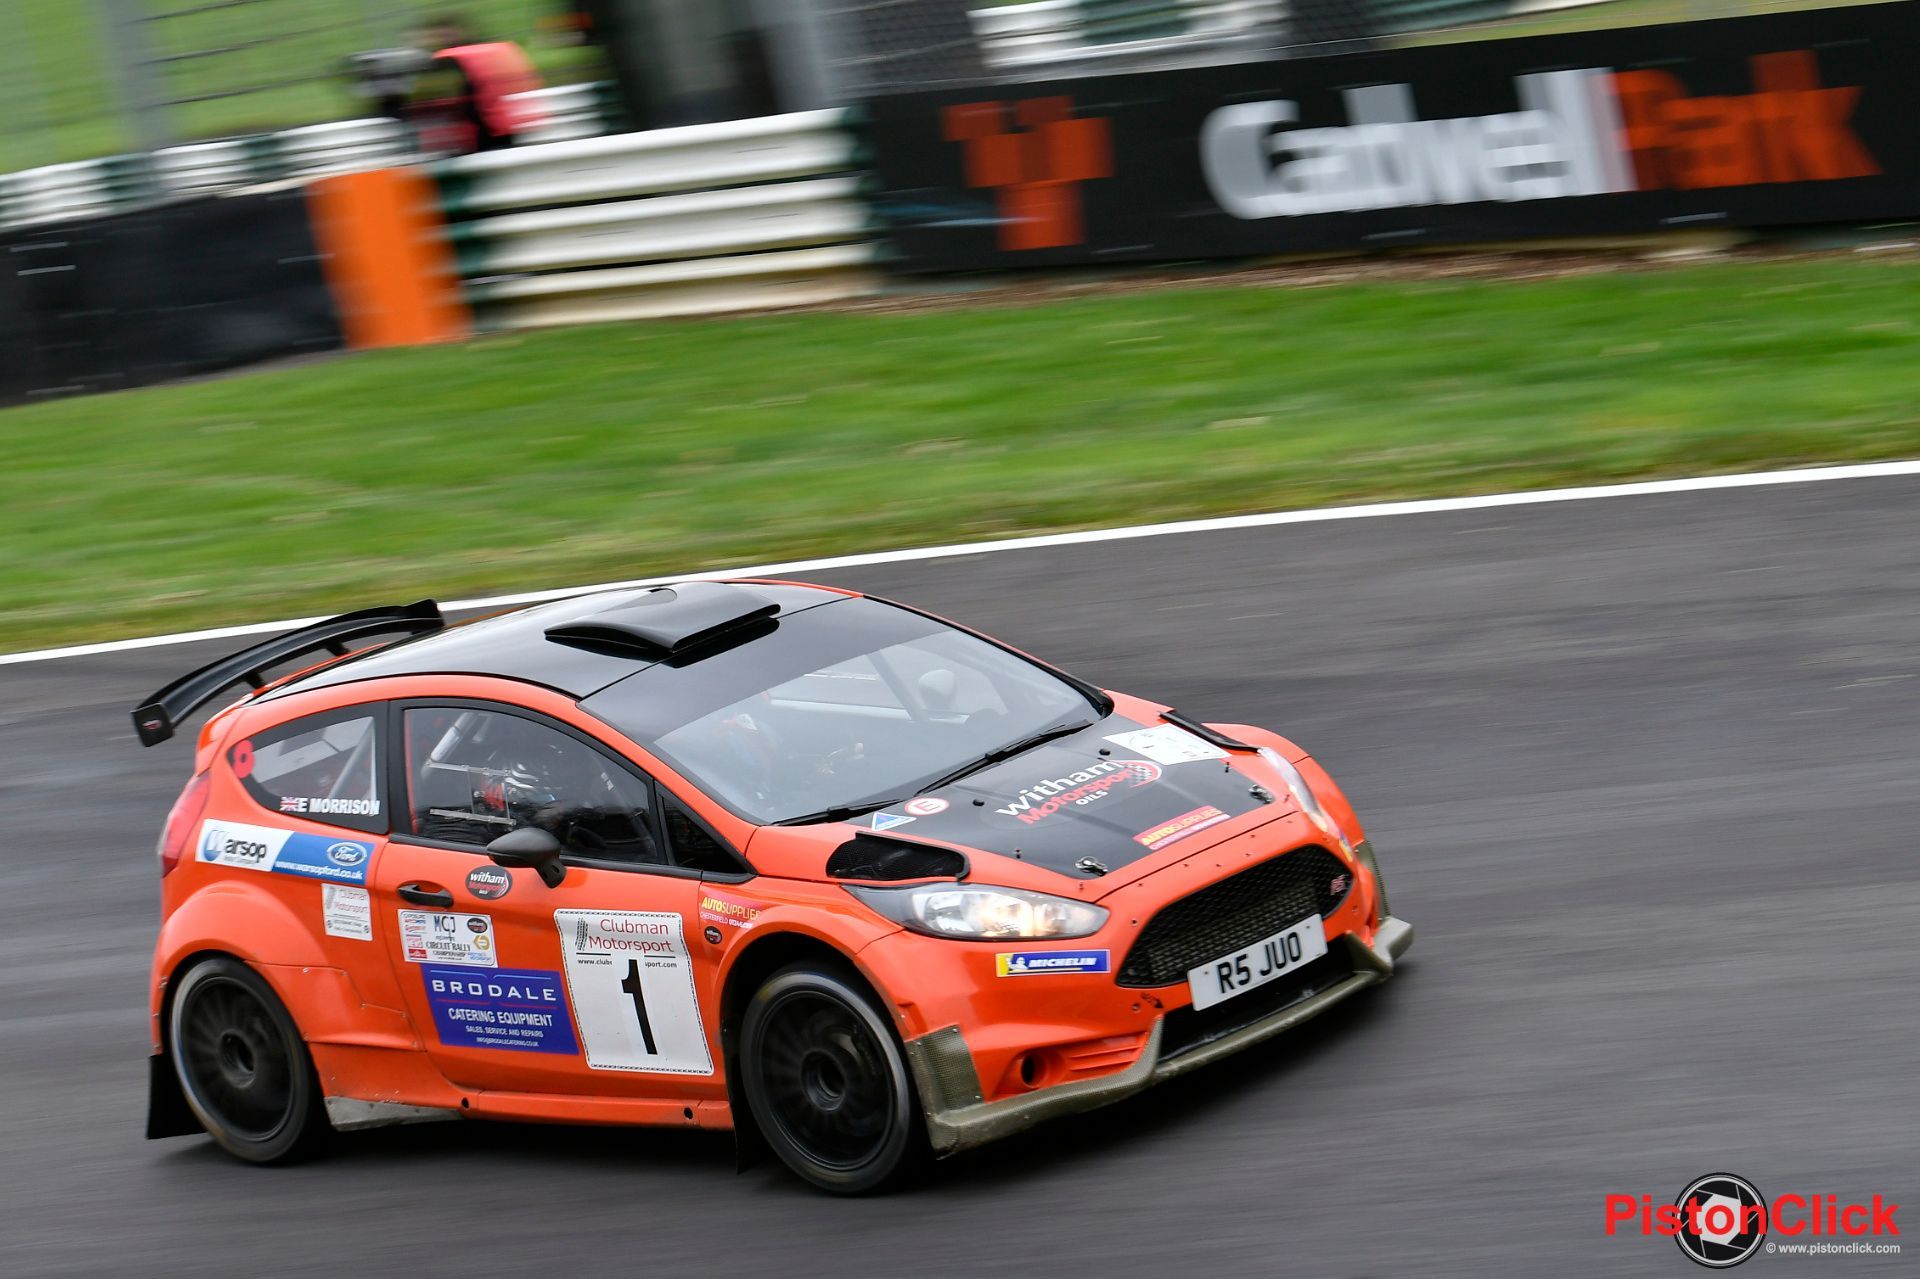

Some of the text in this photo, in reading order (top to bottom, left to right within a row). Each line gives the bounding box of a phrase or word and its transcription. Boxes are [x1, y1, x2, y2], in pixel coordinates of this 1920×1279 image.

[994, 760, 1126, 817] witham
[309, 798, 381, 815] MORRISON
[1075, 790, 1108, 806] OILS
[470, 871, 505, 884] witham
[600, 918, 669, 935] Clubman
[588, 936, 674, 954] Motorsport
[1029, 957, 1096, 968] MICHELIN
[1217, 931, 1302, 993] R5 JUO
[432, 979, 556, 1001] BRODALE
[621, 958, 658, 1055] 1
[448, 1007, 552, 1027] CATERING EQUIPMENT
[508, 1028, 520, 1036] AND
[520, 1029, 544, 1038] REPAIRS
